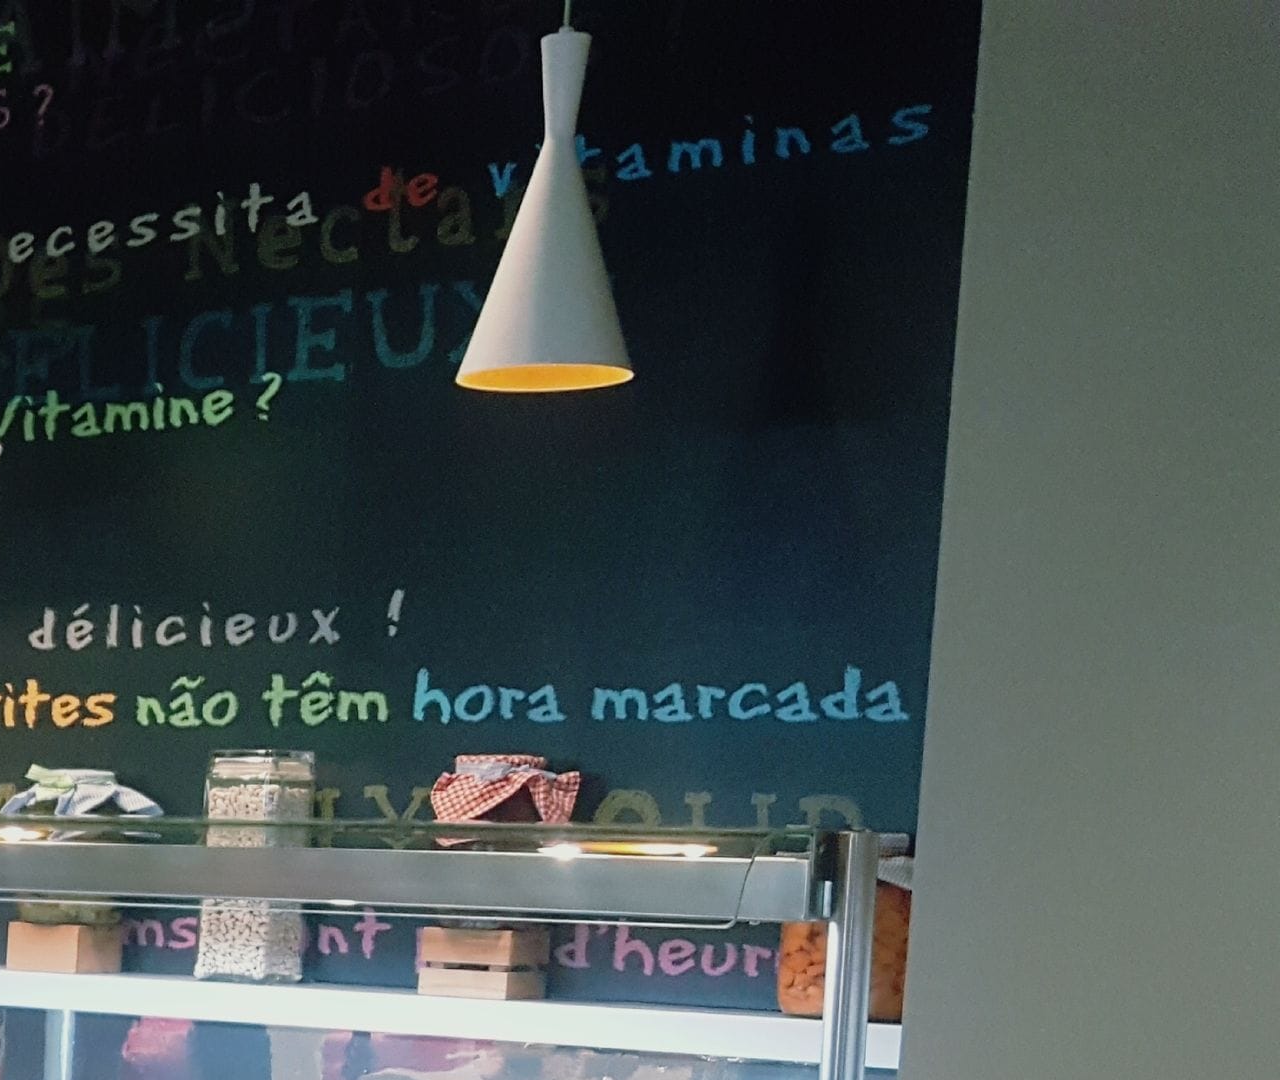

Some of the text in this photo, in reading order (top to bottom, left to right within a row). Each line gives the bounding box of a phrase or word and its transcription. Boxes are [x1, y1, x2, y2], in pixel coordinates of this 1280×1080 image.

[32, 82, 54, 127] ?
[361, 165, 441, 213] de
[486, 103, 936, 200] vtaminas
[255, 371, 283, 422] ?
[28, 602, 342, 652] délicieux
[384, 588, 406, 638] !
[136, 674, 238, 728] não
[262, 671, 390, 727] têm
[412, 665, 568, 725] hora
[592, 663, 911, 724] marcada
